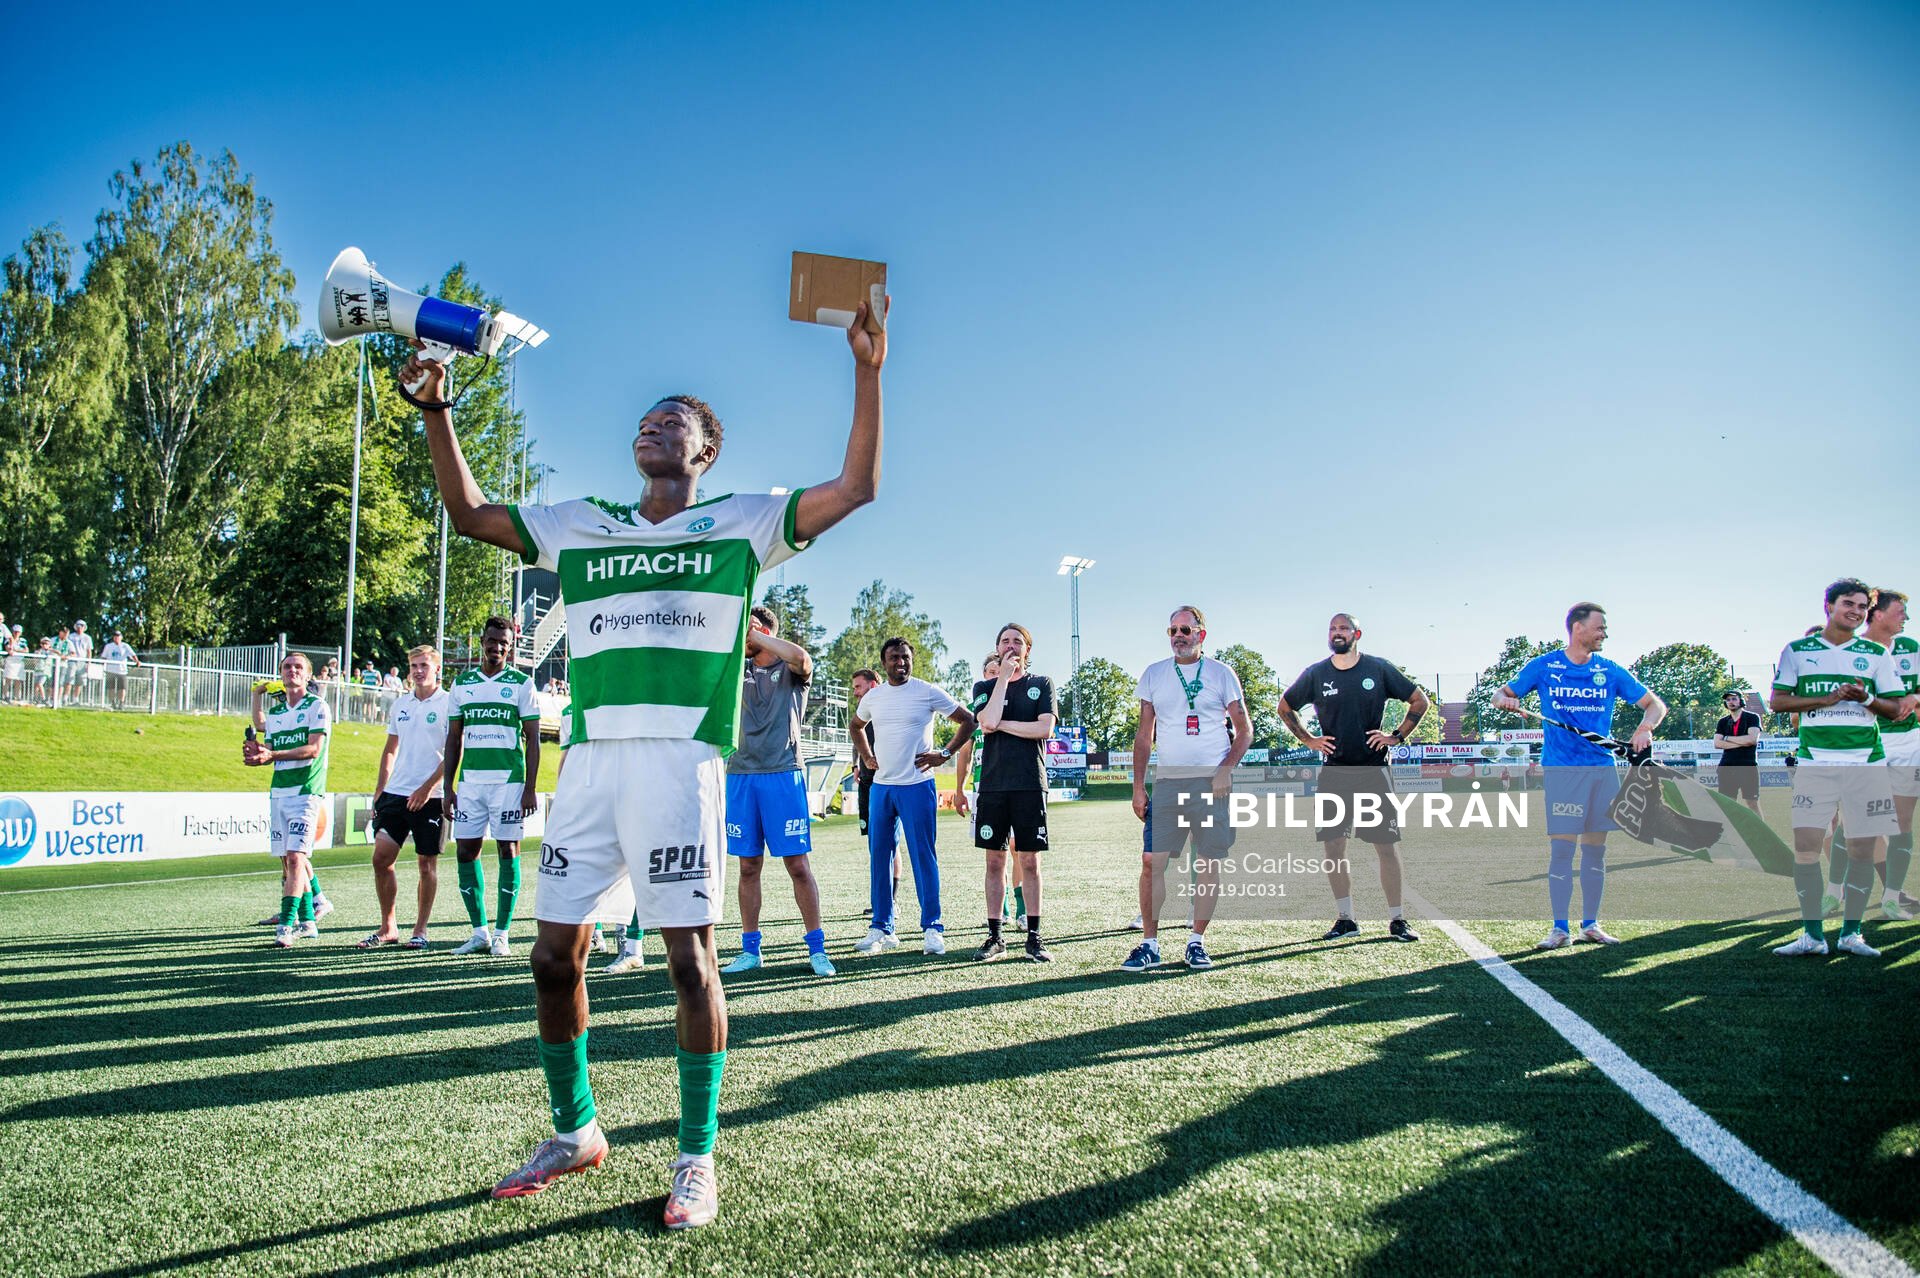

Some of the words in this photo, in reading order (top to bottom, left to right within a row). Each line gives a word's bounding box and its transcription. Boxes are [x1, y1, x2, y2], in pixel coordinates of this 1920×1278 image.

[586, 552, 713, 582] HITACHI
[604, 610, 707, 631] Hygienteknik
[1549, 686, 1607, 699] HITACHI
[464, 708, 511, 720] HITACHI
[72, 799, 125, 826] Best
[1552, 802, 1584, 815] RYDS
[1866, 798, 1894, 812] SPO
[45, 830, 144, 858] Western
[541, 842, 569, 869] DS
[648, 844, 711, 873] SPOL
